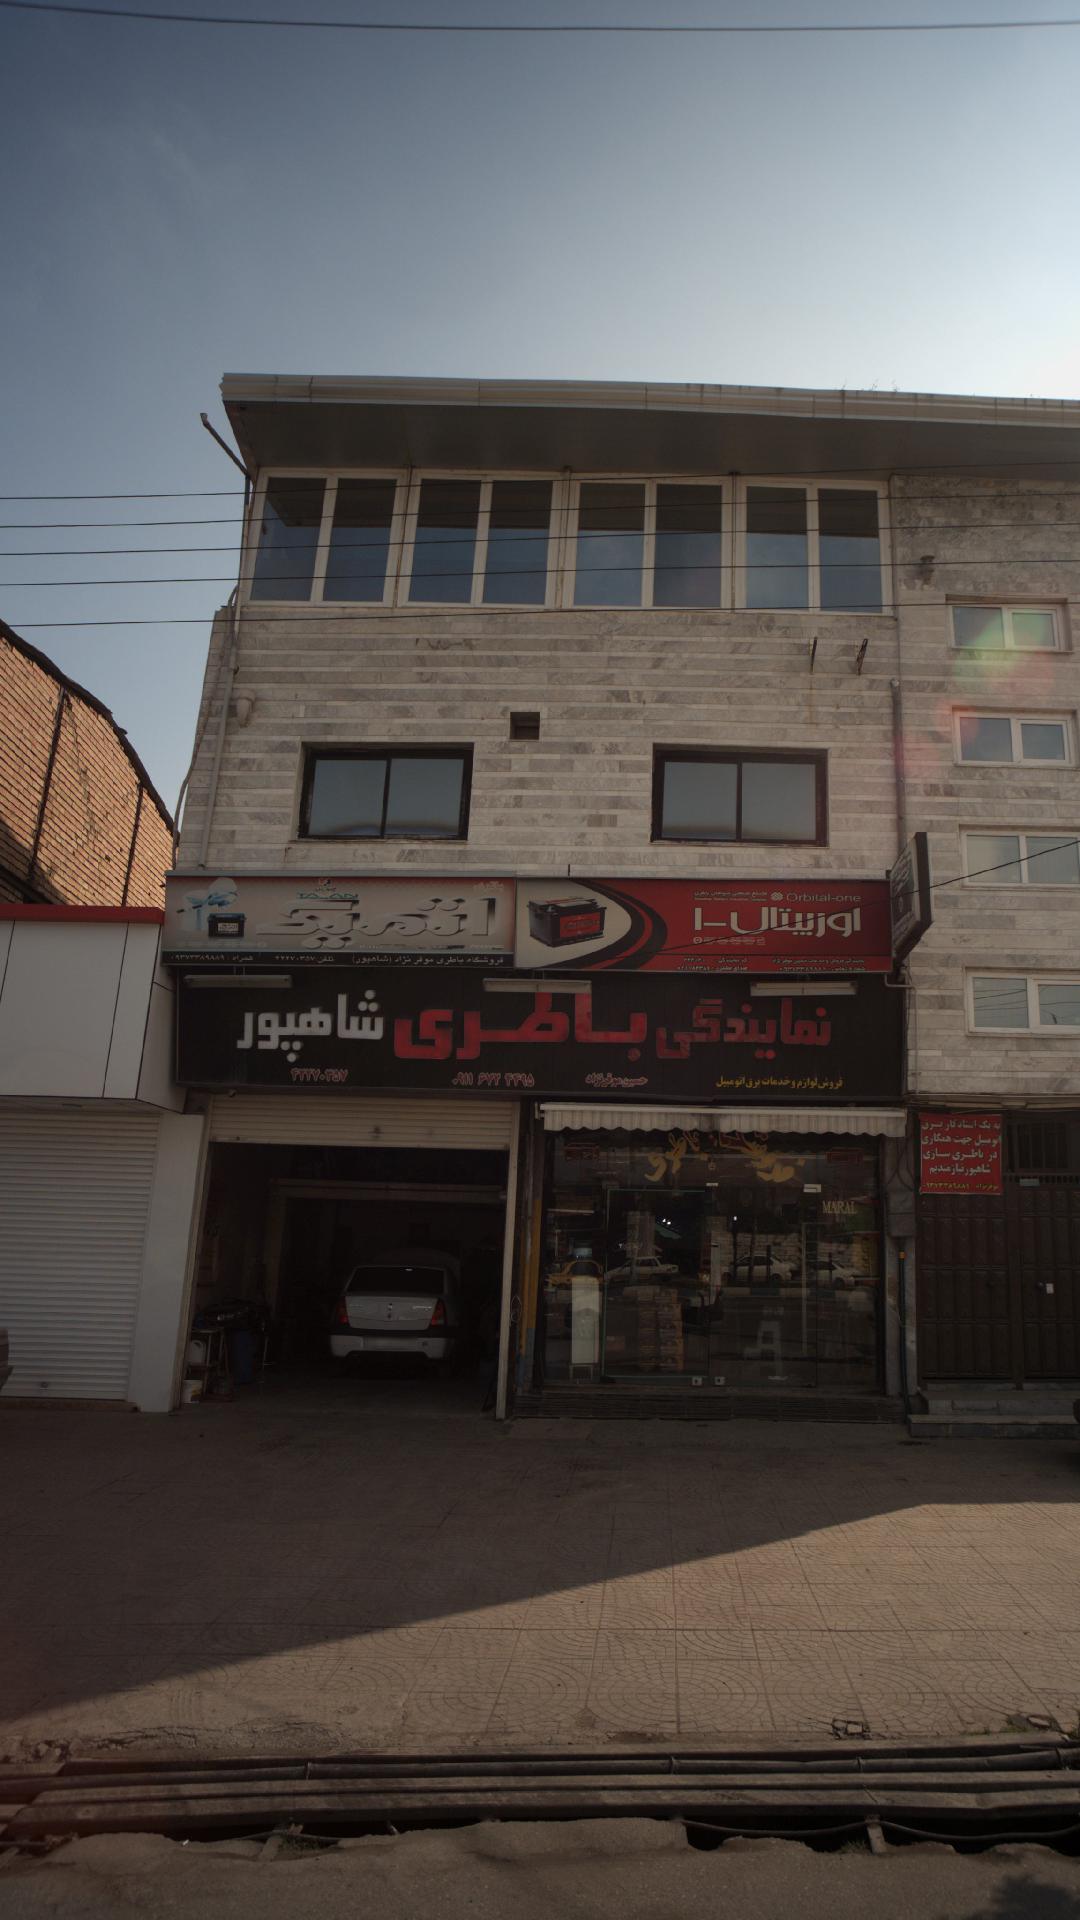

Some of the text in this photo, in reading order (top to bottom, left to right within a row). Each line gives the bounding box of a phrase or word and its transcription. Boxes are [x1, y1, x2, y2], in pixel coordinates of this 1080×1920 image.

[787, 892, 861, 903] Orbital-one
[437, 955, 465, 966] باطری
[467, 955, 505, 966] فروشگاه
[236, 989, 832, 1063] نمایندگی باطری شاهپور
[715, 1075, 745, 1088] اتومبیل
[745, 1078, 761, 1089] برق
[762, 1076, 791, 1086] خدمات
[797, 1076, 818, 1088] لوازم
[818, 1076, 843, 1089] فروش
[921, 1132, 952, 1145] همکاری
[953, 1135, 973, 1146] جهت
[923, 1147, 951, 1160] سازی
[952, 1148, 984, 1161] باطری
[822, 1199, 857, 1214] MARAL
